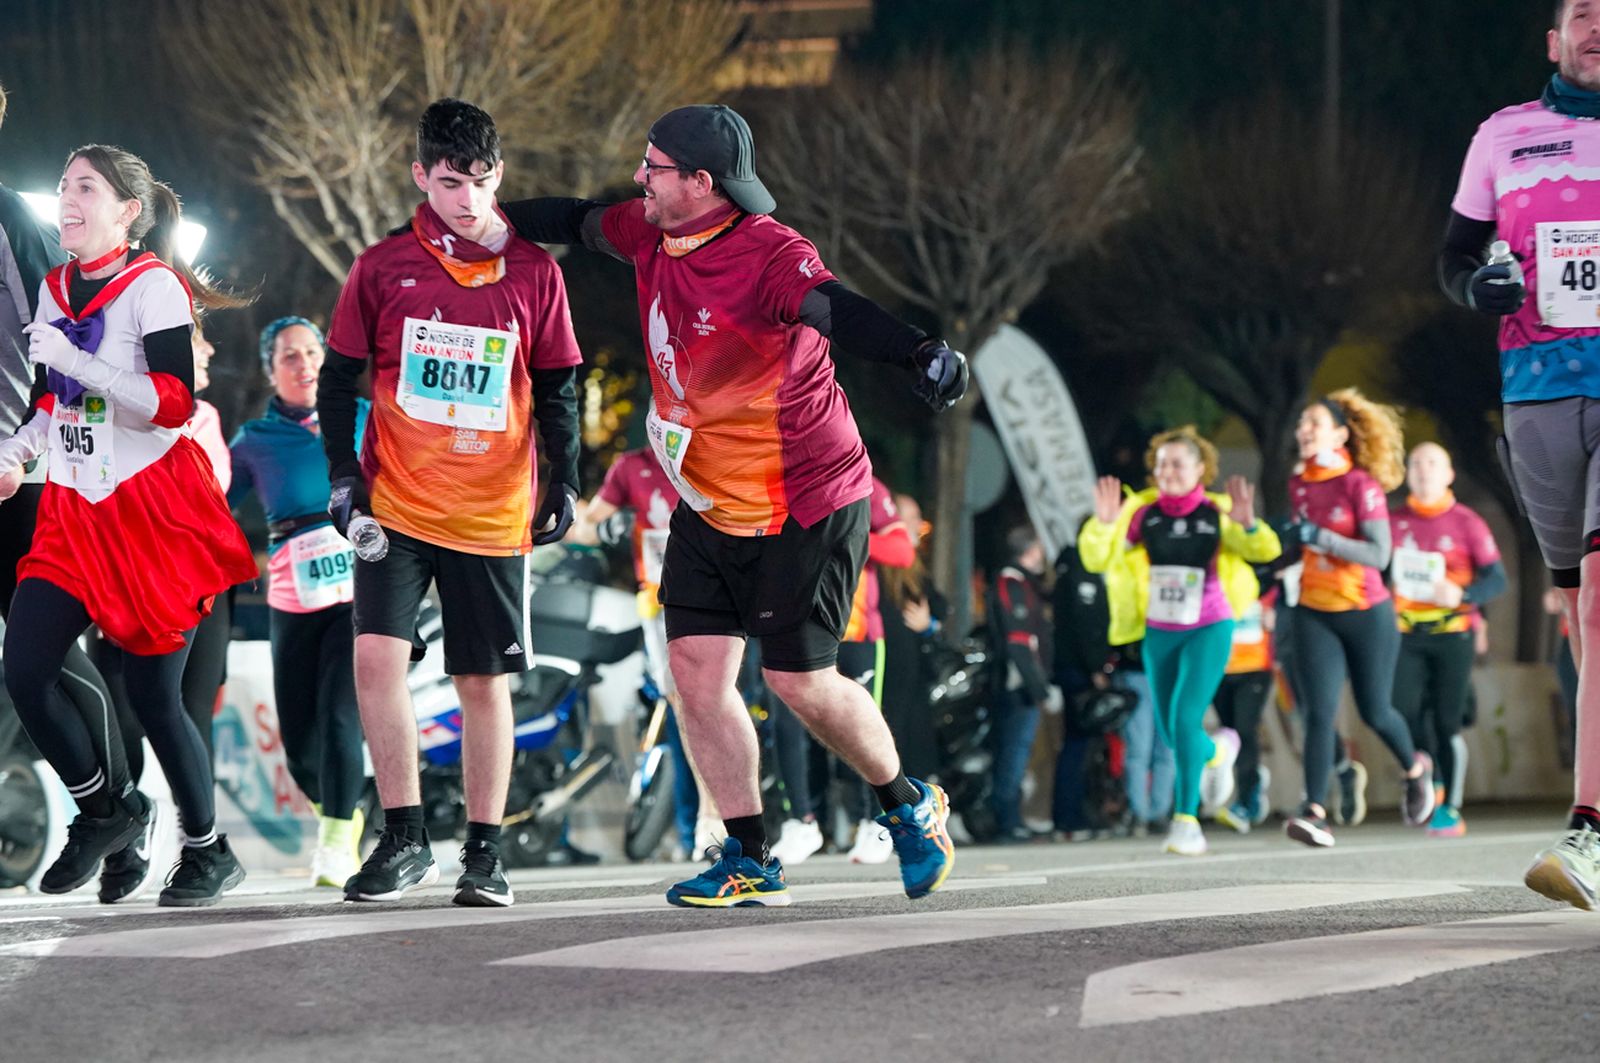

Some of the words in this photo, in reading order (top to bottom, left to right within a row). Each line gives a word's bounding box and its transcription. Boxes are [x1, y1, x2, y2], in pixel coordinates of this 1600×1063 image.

[1565, 233, 1599, 244] NOCHE
[429, 334, 462, 347] NOCHE
[462, 337, 475, 348] DE
[414, 343, 436, 356] SAN
[422, 358, 491, 395] 8647
